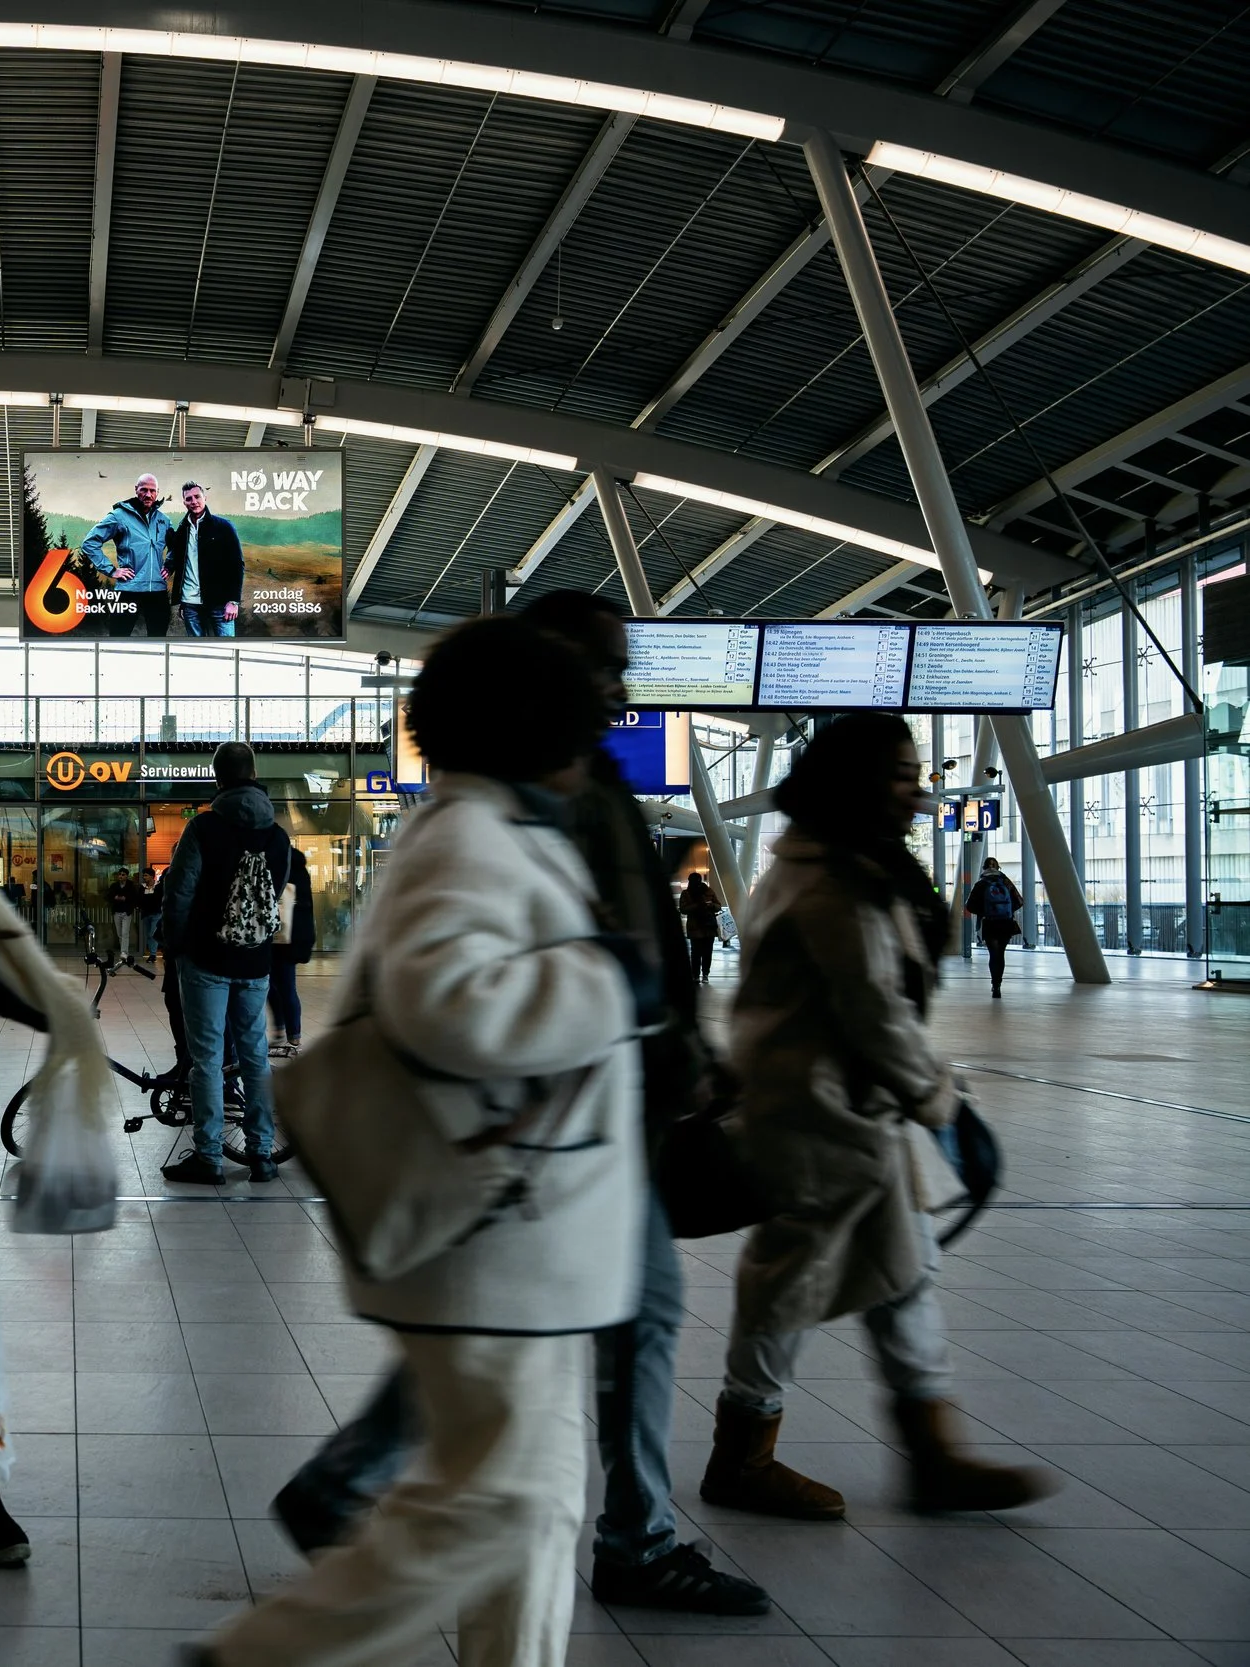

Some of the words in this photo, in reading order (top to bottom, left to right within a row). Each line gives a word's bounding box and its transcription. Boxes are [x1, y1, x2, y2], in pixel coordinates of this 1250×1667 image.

[231, 468, 267, 491] NO
[273, 470, 323, 490] WAY
[244, 492, 308, 511] BACK
[25, 549, 88, 634] 6
[76, 589, 93, 600] No
[95, 589, 121, 602] Way
[253, 588, 304, 602] zondag
[76, 602, 105, 614] Back
[107, 602, 137, 614] VIPS
[253, 602, 286, 614] 20:30
[288, 602, 322, 614] SBS6
[89, 762, 132, 782] OV
[141, 764, 216, 778] Servicewink
[984, 811, 992, 828] D
